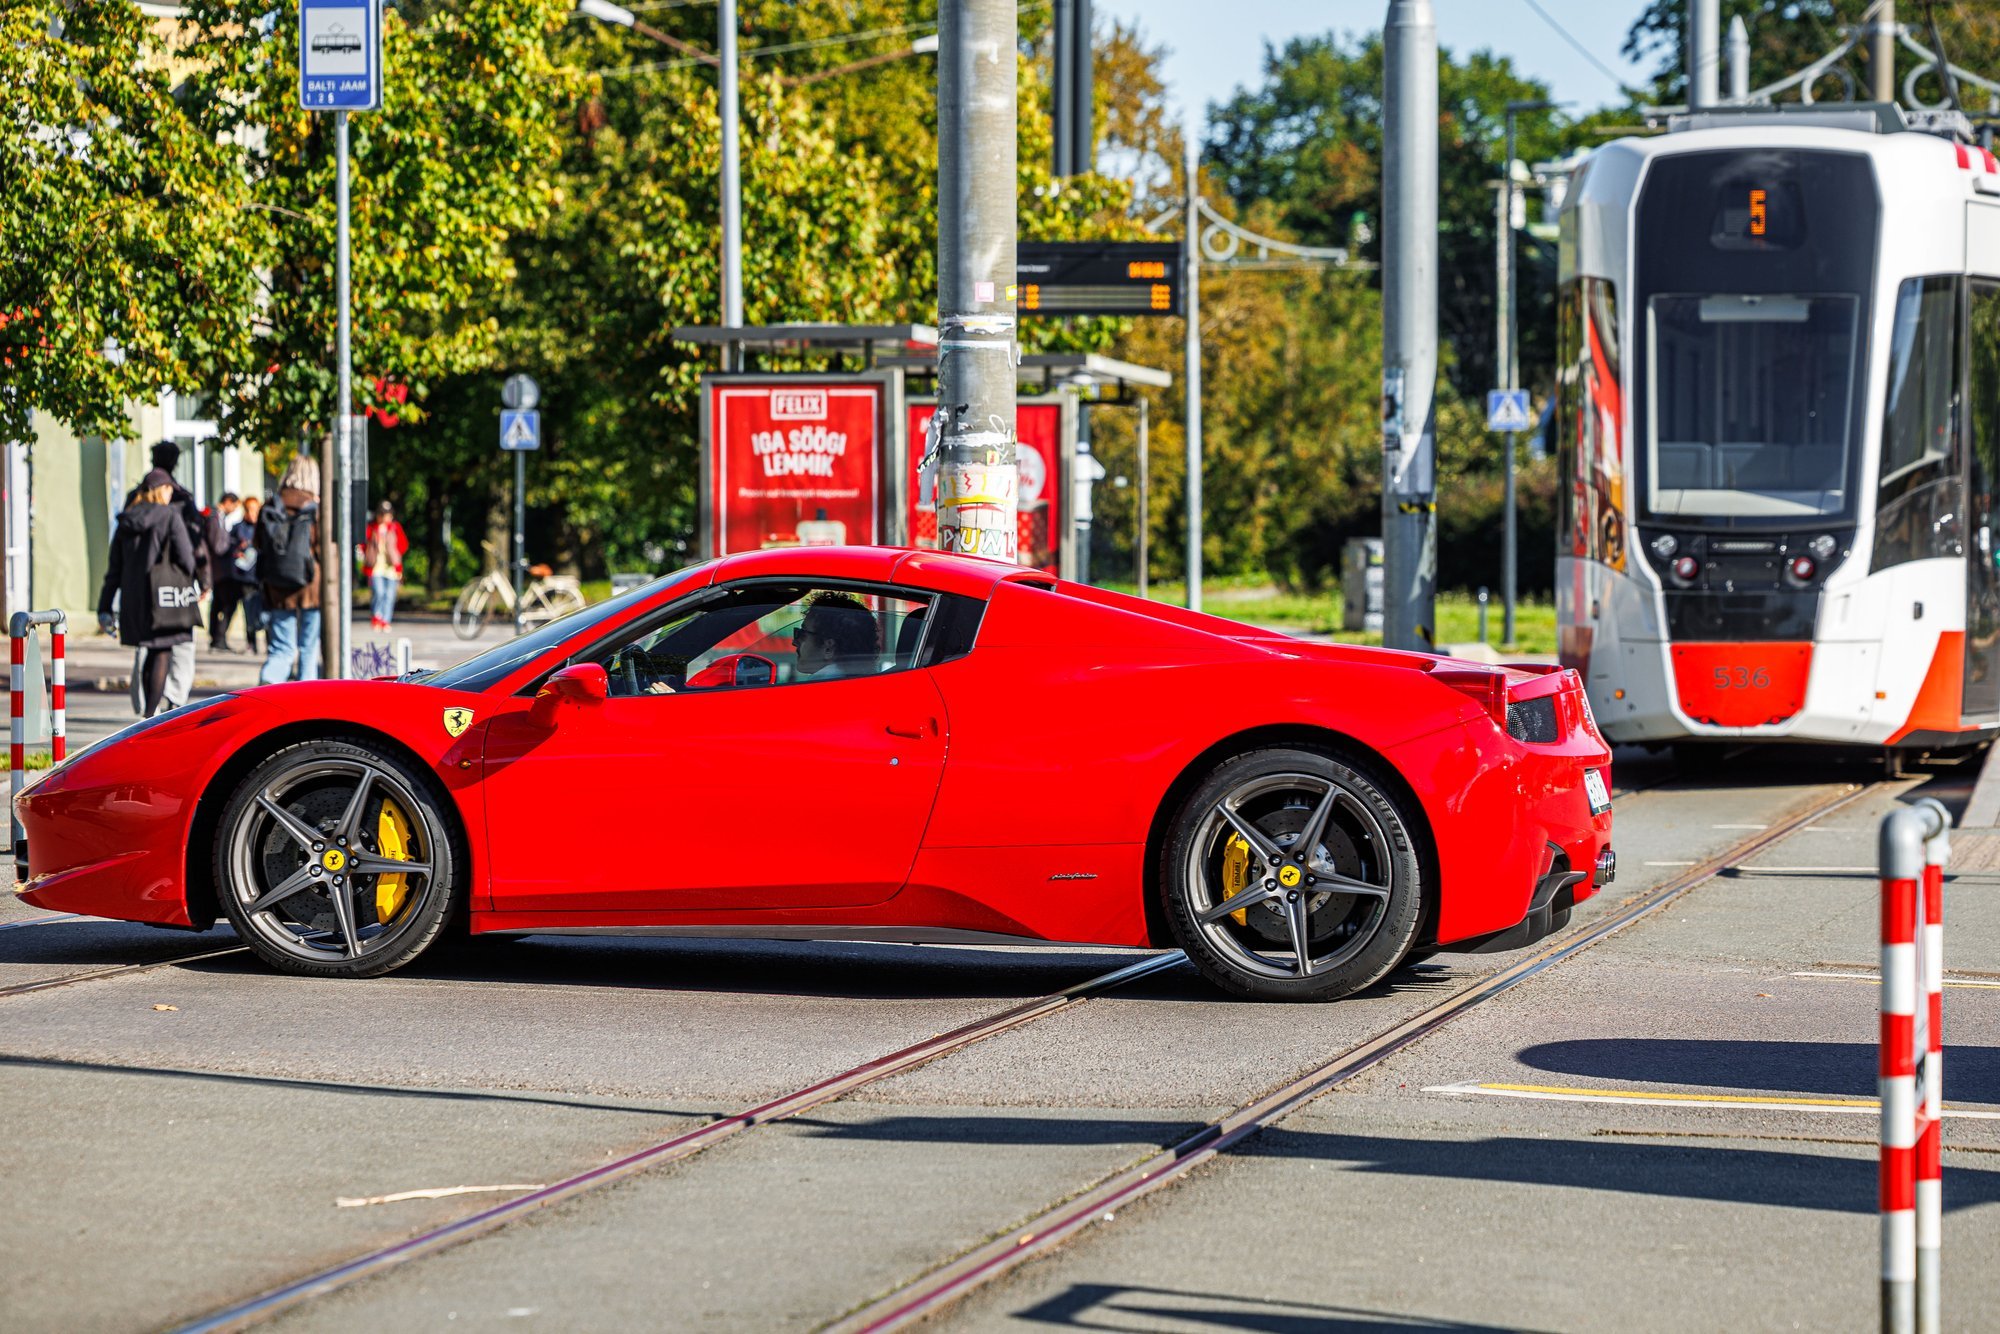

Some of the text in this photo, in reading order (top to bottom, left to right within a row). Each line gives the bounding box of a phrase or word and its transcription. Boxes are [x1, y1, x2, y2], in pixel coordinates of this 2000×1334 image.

[307, 80, 366, 91] BALTI JAAM
[1750, 189, 1767, 235] 5
[776, 396, 821, 414] FELIX
[752, 431, 786, 456] IGA
[763, 453, 834, 477] LEMMIK
[1714, 666, 1770, 689] 536
[327, 746, 380, 761] MICHELIN
[1350, 774, 1406, 848] MICHELIN
[1400, 884, 1410, 912] SPORT
